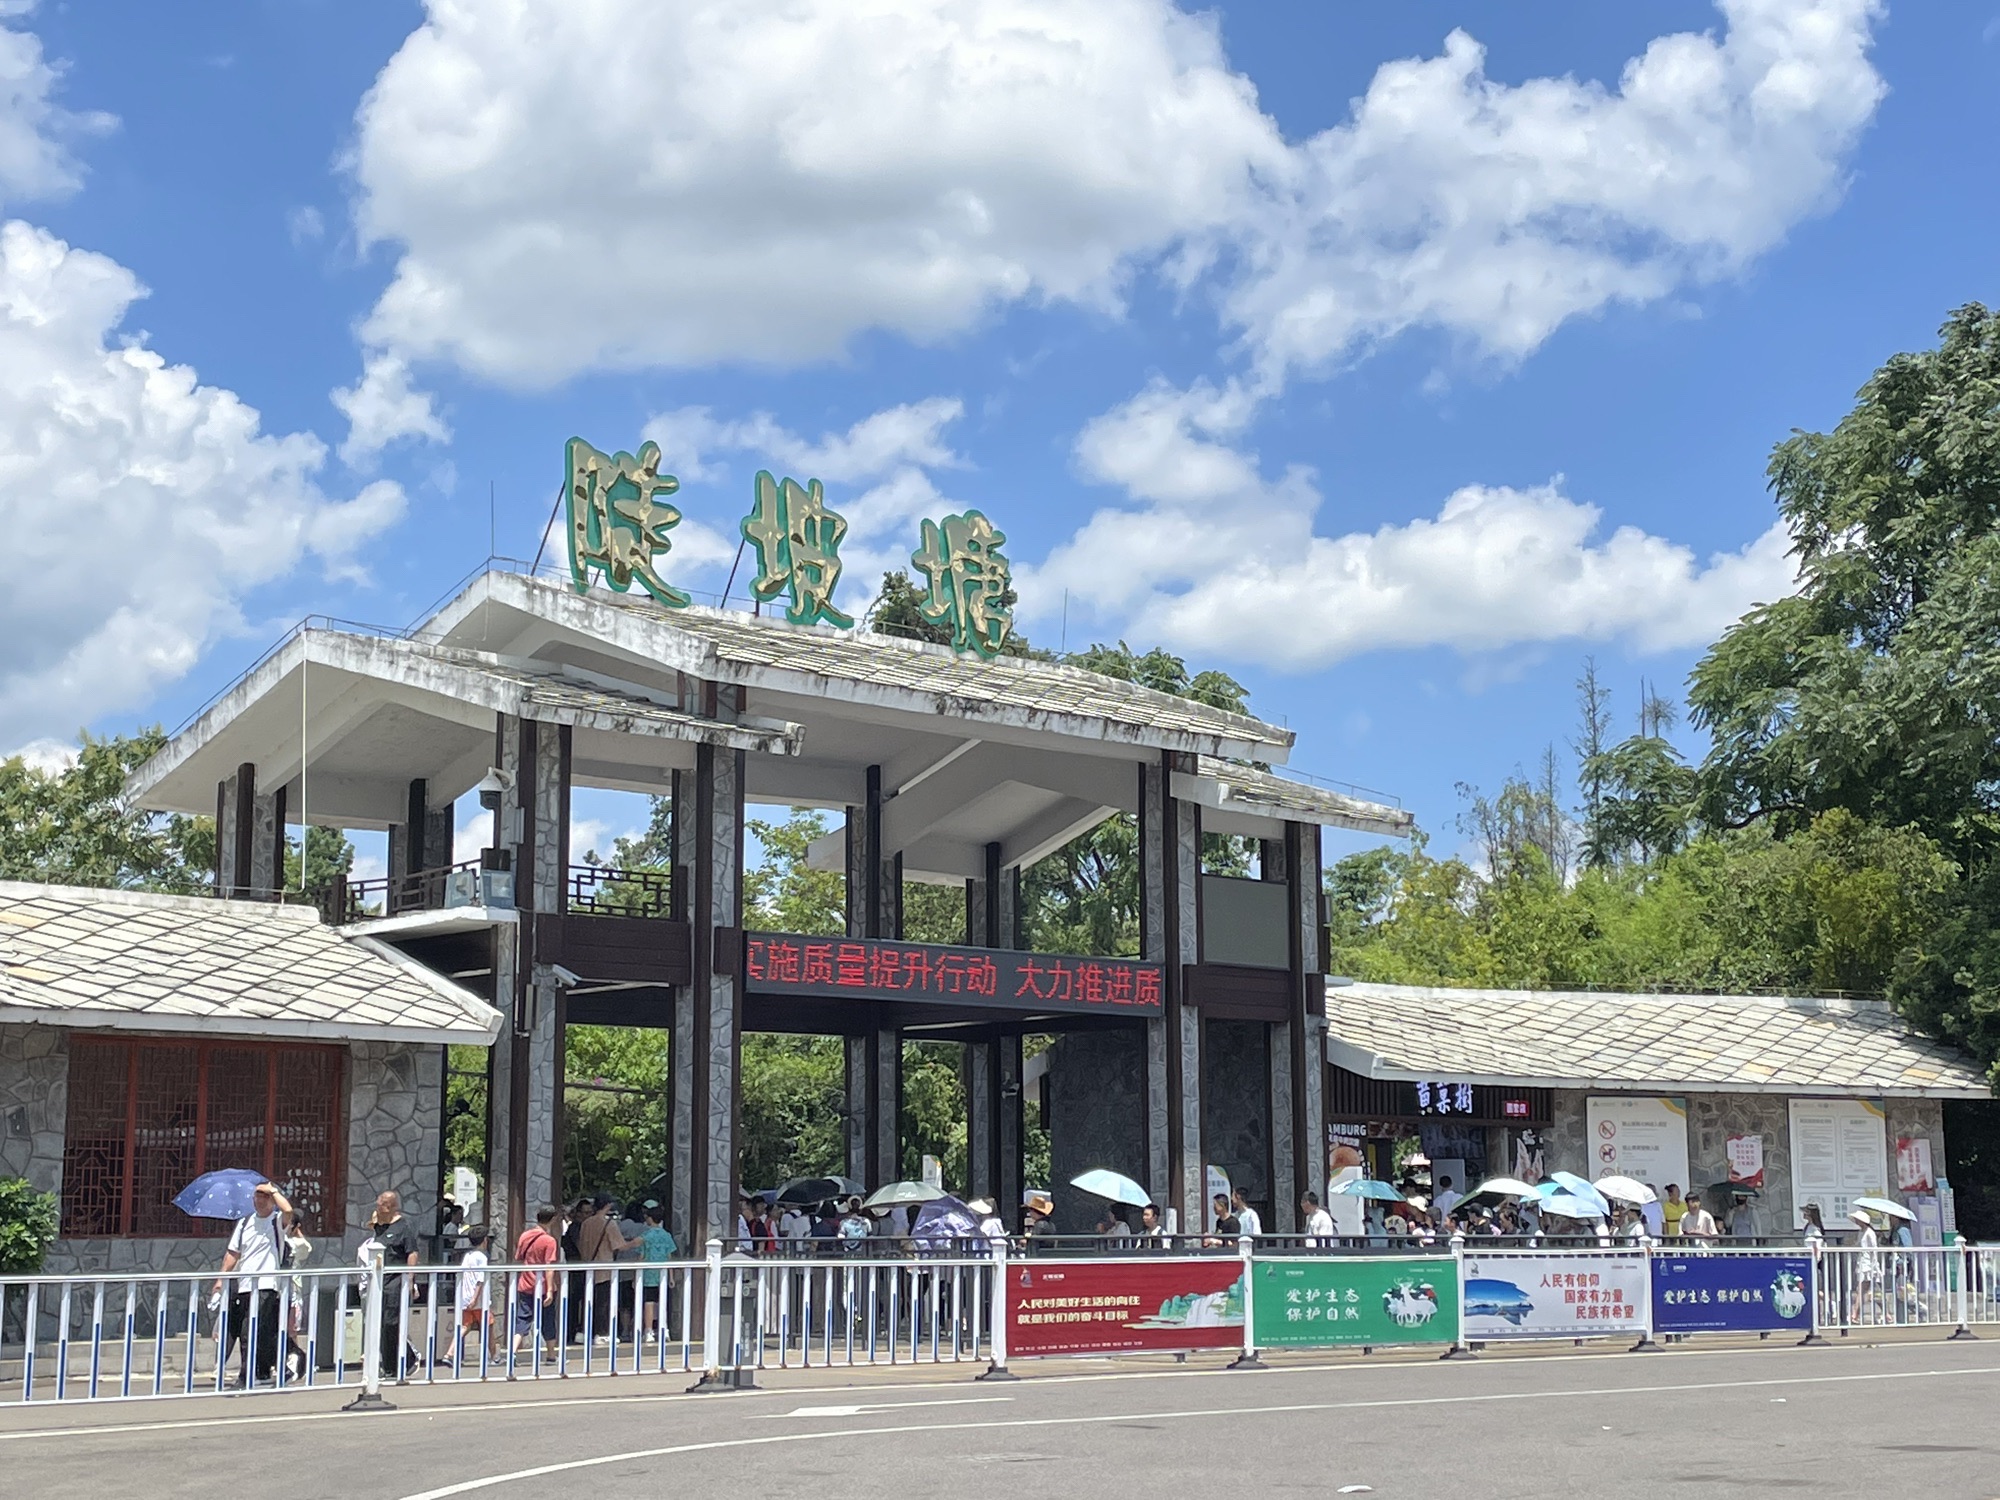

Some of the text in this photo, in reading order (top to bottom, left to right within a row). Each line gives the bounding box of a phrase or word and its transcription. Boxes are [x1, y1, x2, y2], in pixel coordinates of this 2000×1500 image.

[1015, 958, 1161, 1007] 大力推进质
[1540, 1273, 1600, 1288] 人民有信仰
[1017, 1295, 1141, 1309] 人民对美好生活的向往
[1286, 1288, 1360, 1304] 爱护生态
[1564, 1289, 1624, 1304] 国家有力量
[1664, 1289, 1764, 1304] 爱护生态 保护自然
[1017, 1310, 1129, 1325] 就是我们的奋斗目标
[1286, 1306, 1359, 1321] 保护自然
[1575, 1305, 1635, 1319] 民族有希望
